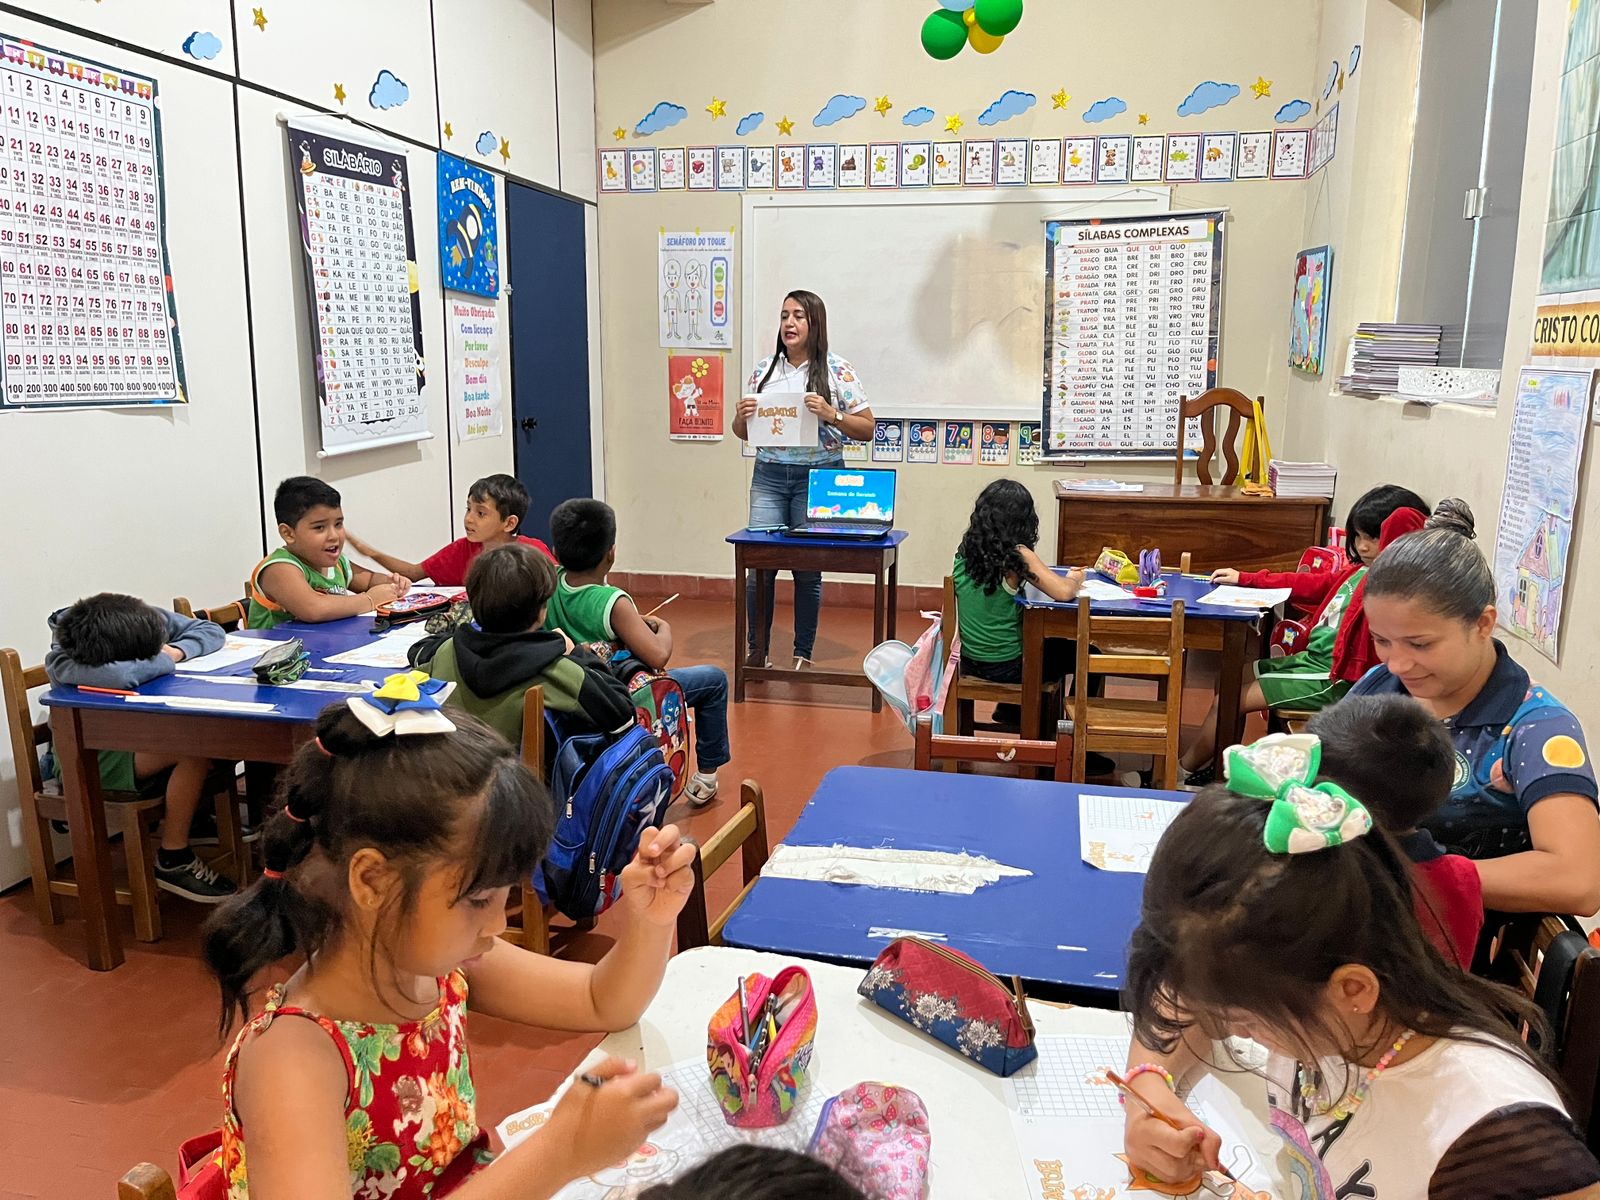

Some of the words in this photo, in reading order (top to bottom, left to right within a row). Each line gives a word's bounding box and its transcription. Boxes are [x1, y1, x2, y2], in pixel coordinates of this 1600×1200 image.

[8, 75, 12, 86] 1
[26, 80, 32, 91] 2
[44, 84, 50, 95] 3
[62, 90, 68, 99] 4
[79, 93, 84, 103] 5
[95, 98, 100, 108] 6
[110, 101, 115, 111] 7
[126, 106, 131, 115] 8
[140, 110, 145, 119] 9
[324, 149, 382, 176] SILABÁRIO
[1078, 229, 1121, 241] SÍLABAS
[1124, 226, 1189, 239] COMPLEXAS
[1, 230, 12, 241] 50
[18, 232, 29, 243] 51
[36, 234, 48, 245] 52
[53, 236, 64, 247] 53
[70, 238, 81, 249] 54
[86, 240, 96, 251] 55
[102, 242, 112, 252] 56
[117, 244, 127, 254] 57
[133, 246, 142, 256] 58
[147, 248, 157, 258] 59
[667, 236, 696, 246] SEMÁFORO
[454, 306, 469, 316] Muito
[471, 307, 495, 320] Obrigada
[6, 324, 18, 334] 80
[24, 324, 35, 334] 81
[42, 325, 52, 335] 82
[58, 325, 69, 335] 83
[74, 326, 85, 336] 84
[91, 327, 102, 336] 85
[107, 327, 118, 337] 86
[123, 328, 133, 337] 87
[138, 329, 149, 338] 88
[154, 329, 165, 338] 89
[461, 324, 472, 334] Com
[474, 324, 493, 337] licença
[1534, 315, 1578, 344] CRISTO
[1581, 314, 1600, 344] CO
[465, 341, 474, 351] Por
[474, 341, 488, 351] favor
[8, 354, 20, 365] 90
[26, 355, 36, 365] 91
[43, 355, 54, 364] 92
[60, 355, 71, 365] 93
[76, 355, 88, 365] 94
[92, 355, 104, 365] 95
[109, 356, 120, 365] 96
[124, 356, 135, 365] 97
[141, 356, 152, 365] 98
[157, 356, 168, 365] 99
[465, 358, 488, 369] Desculpe
[466, 375, 478, 384] Bom
[479, 374, 487, 383] dia
[7, 384, 23, 394] 100
[27, 384, 40, 392] 200
[43, 384, 57, 392] 300
[78, 383, 91, 391] 500
[94, 383, 107, 391] 600
[158, 382, 175, 390] 1000
[464, 392, 474, 402] Boa
[475, 390, 489, 400] tarde
[466, 408, 476, 418] Boa
[477, 407, 491, 417] Noite
[467, 424, 476, 435] Até
[477, 424, 488, 435] logo
[875, 423, 887, 441] 5
[910, 423, 921, 442] 6
[947, 424, 959, 442] 7
[982, 424, 993, 442] 8
[1020, 425, 1031, 444] 9
